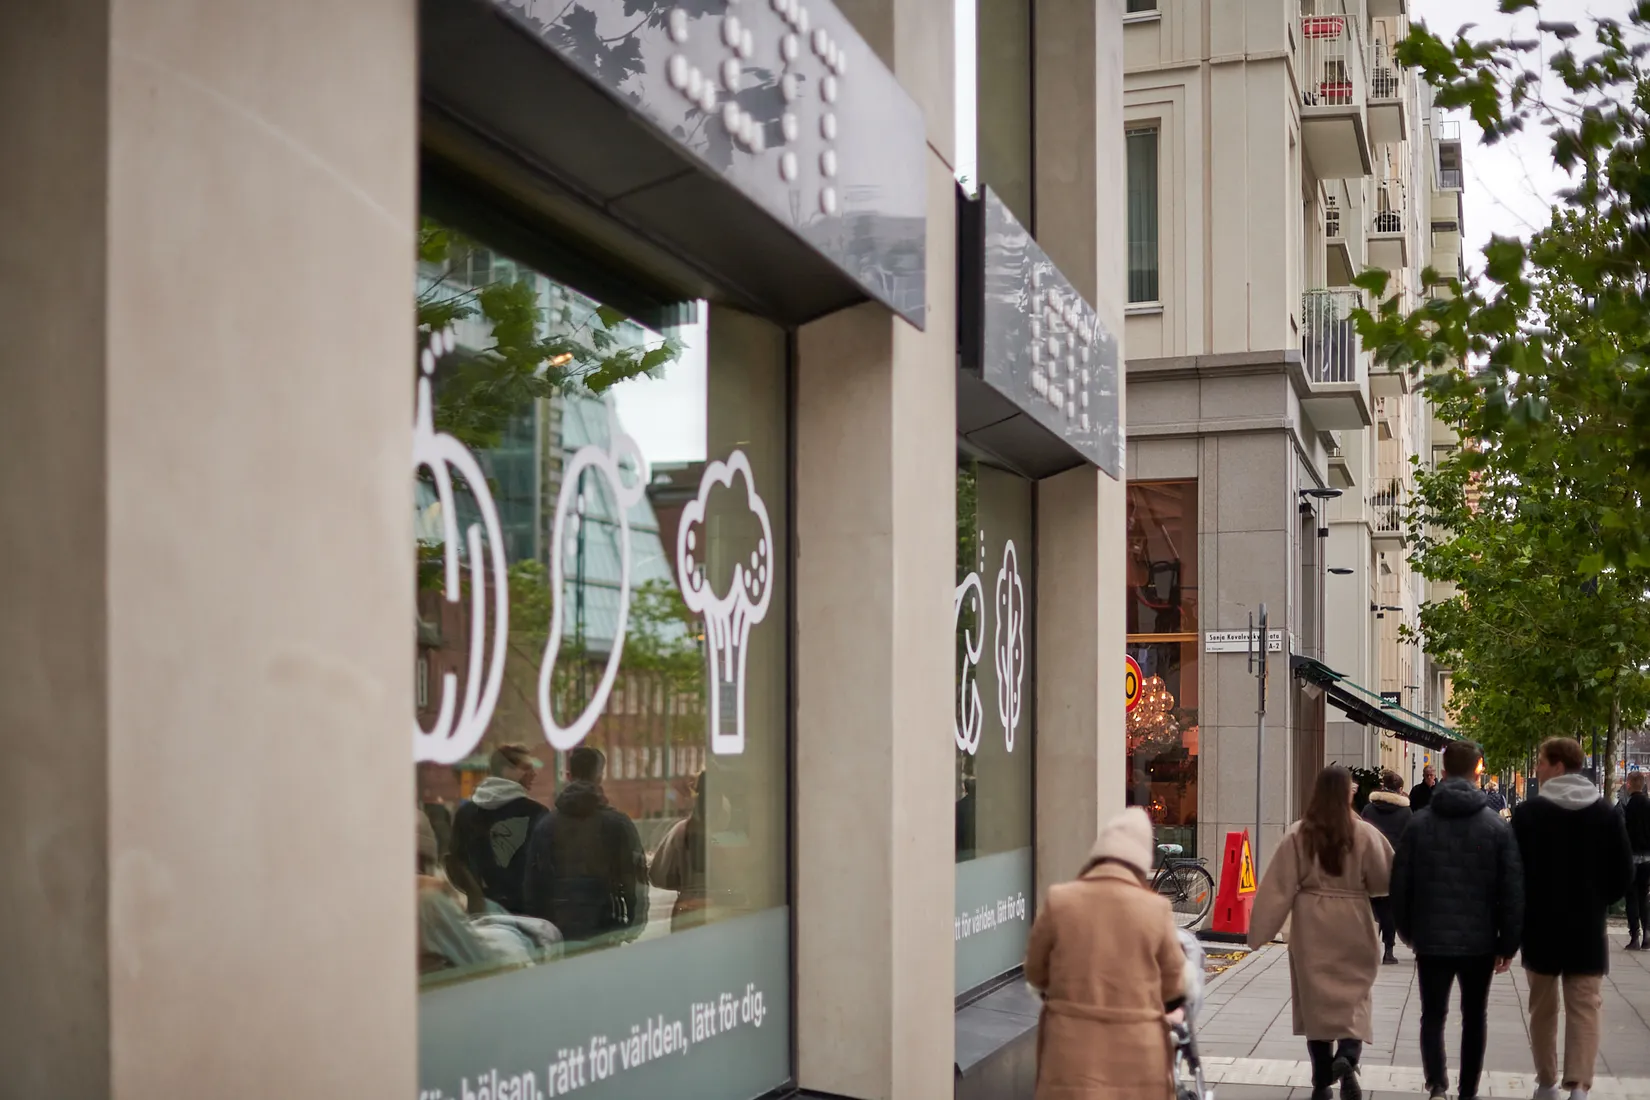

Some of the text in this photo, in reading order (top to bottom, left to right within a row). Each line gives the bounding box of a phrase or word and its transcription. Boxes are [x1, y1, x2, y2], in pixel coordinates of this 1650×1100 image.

[1209, 634, 1225, 642] Sonja
[549, 1047, 586, 1098] rätt
[589, 1034, 617, 1083] för
[620, 1013, 688, 1071] världen,
[691, 1001, 717, 1044] lätt
[719, 992, 739, 1033] för
[741, 983, 766, 1028] dig.
